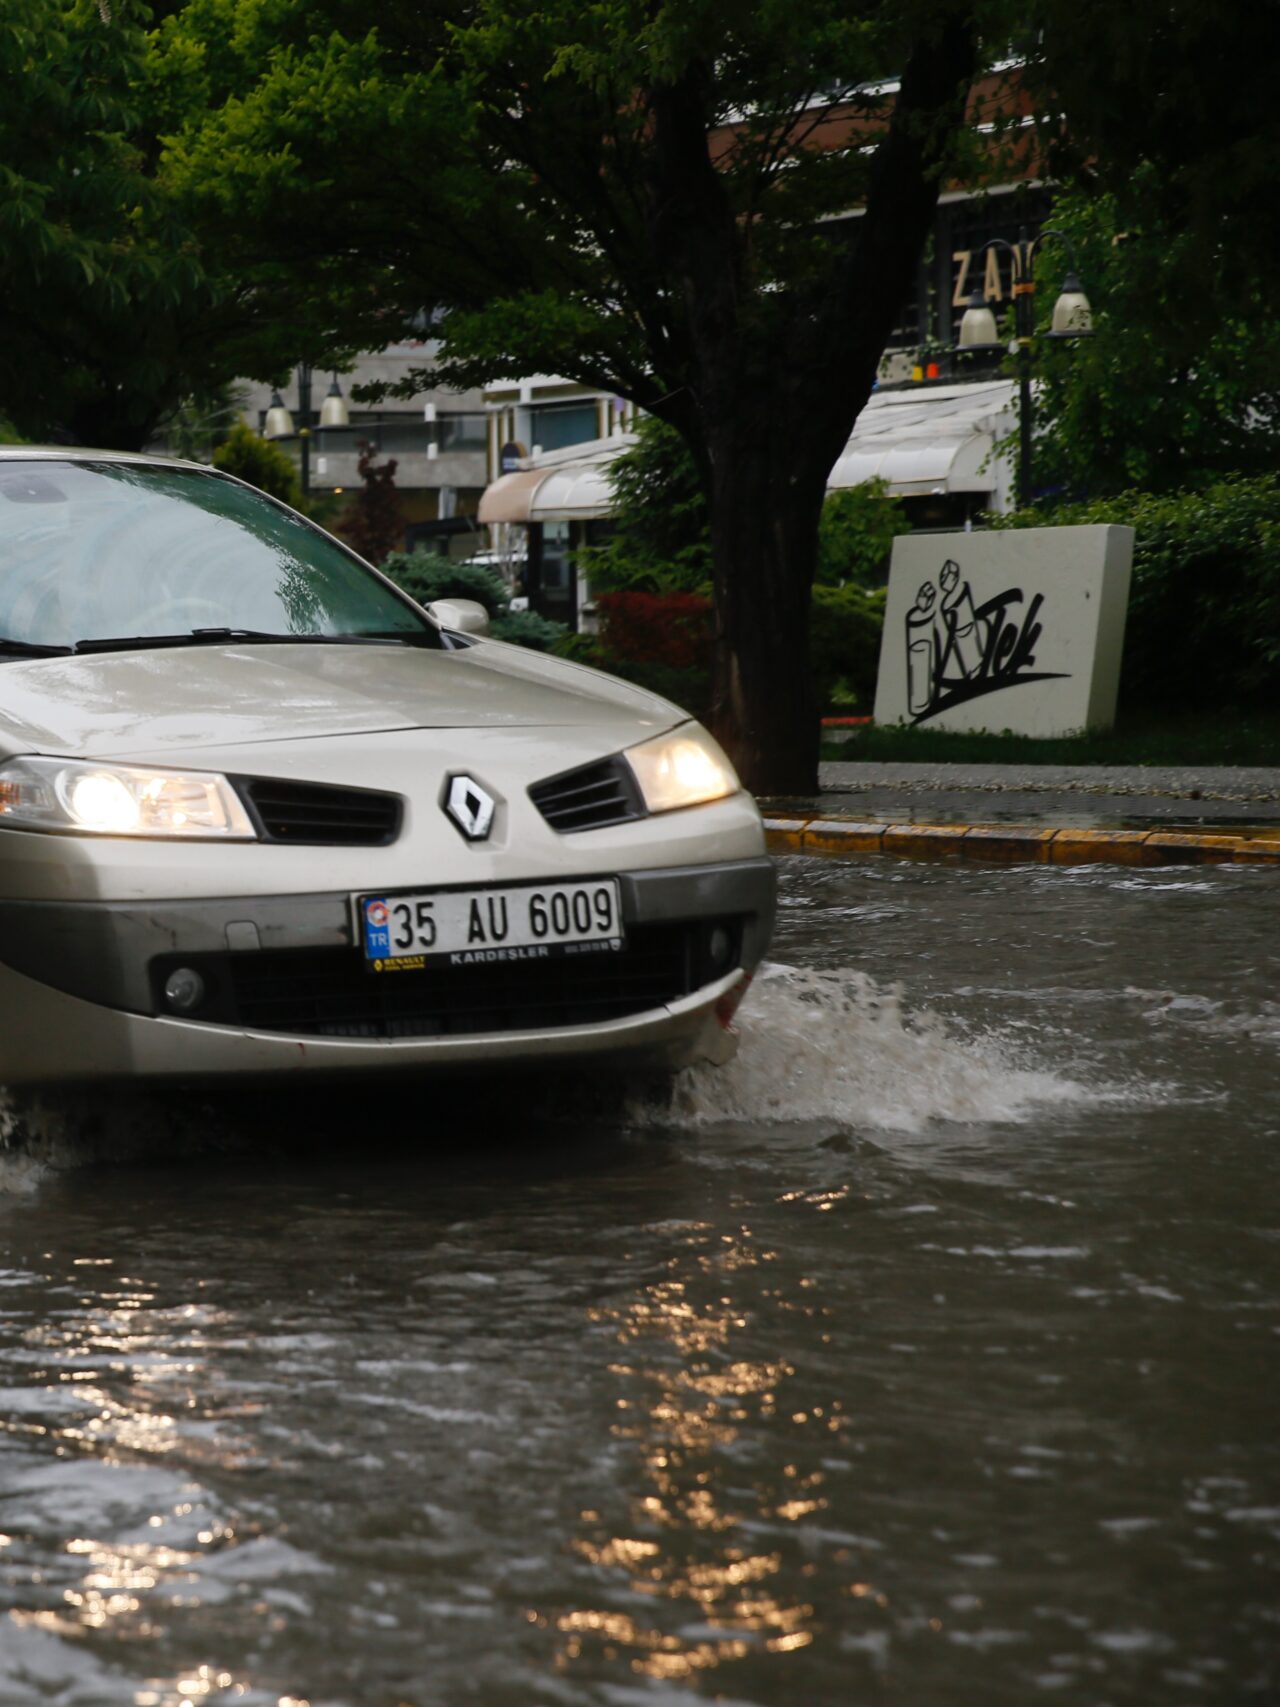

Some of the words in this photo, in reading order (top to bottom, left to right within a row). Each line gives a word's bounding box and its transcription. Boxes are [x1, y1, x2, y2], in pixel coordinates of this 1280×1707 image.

[392, 901, 437, 949] 35
[467, 896, 509, 943] AU
[528, 887, 612, 938] 6009
[370, 932, 389, 947] TR
